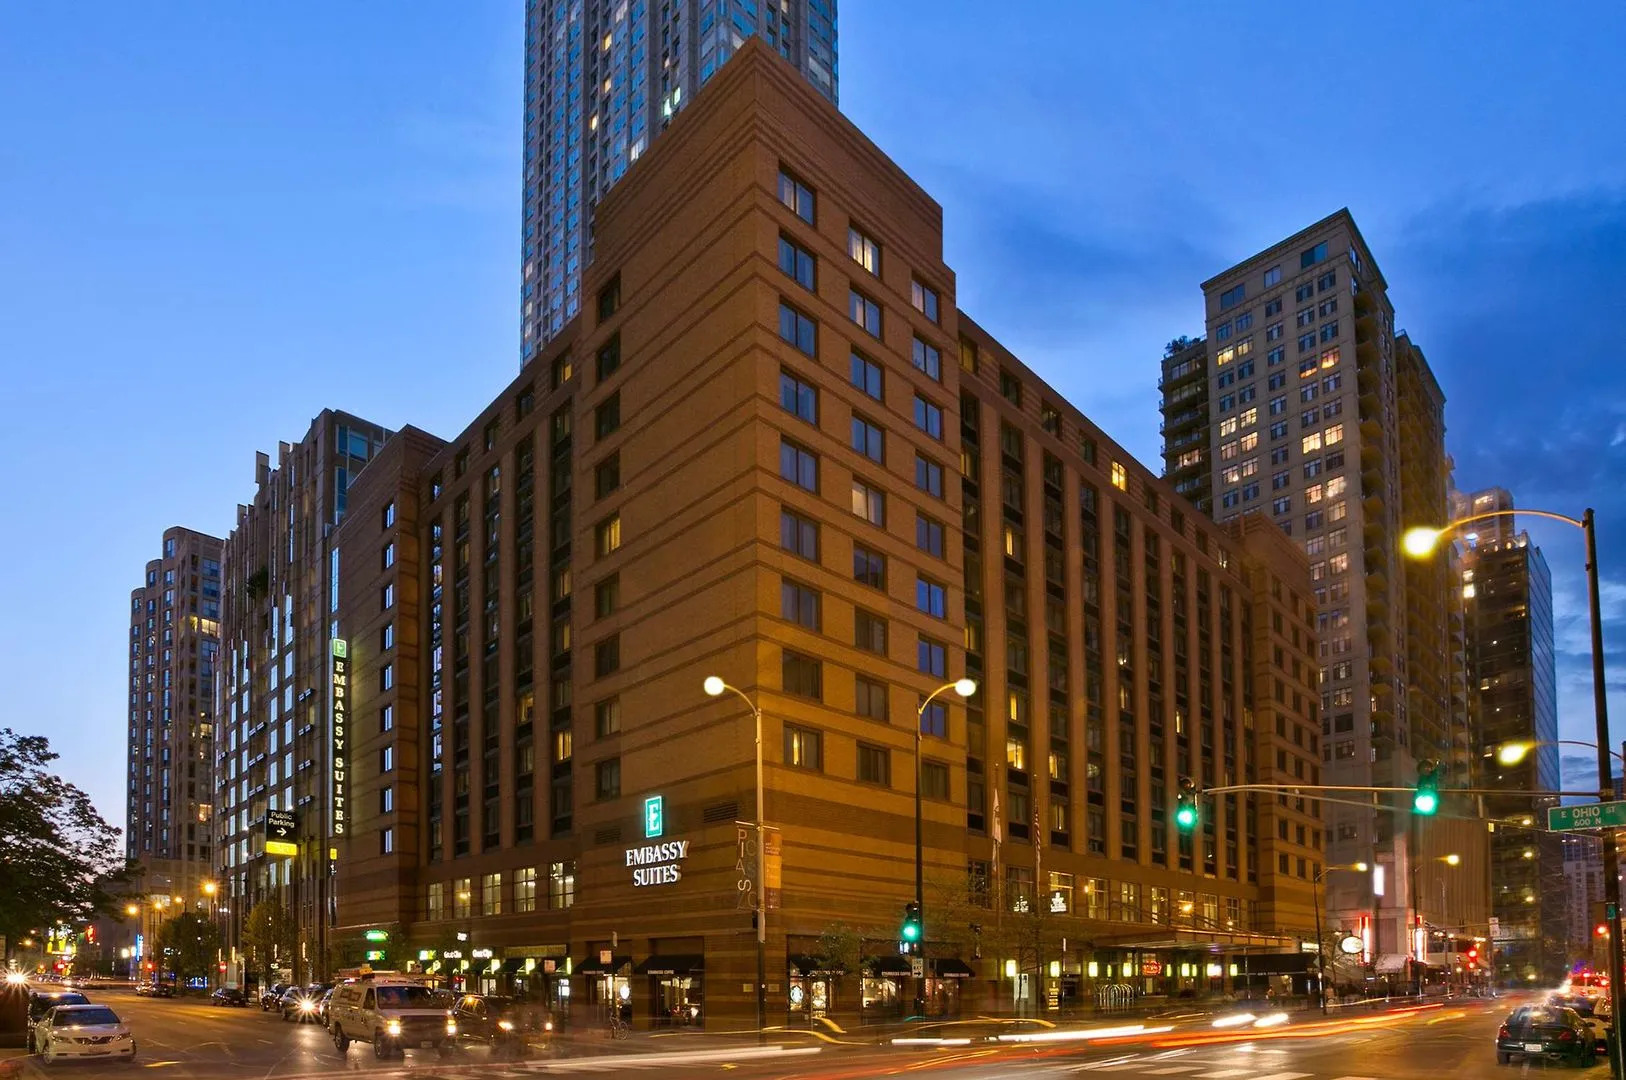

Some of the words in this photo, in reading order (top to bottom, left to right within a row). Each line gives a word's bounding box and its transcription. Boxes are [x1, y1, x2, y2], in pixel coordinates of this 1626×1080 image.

[333, 661, 346, 750] EMBASSY
[334, 757, 345, 834] SUITES
[270, 811, 293, 821] Public
[1572, 806, 1600, 818] OHIO
[1606, 806, 1616, 814] ST
[268, 818, 295, 829] Parking
[1574, 819, 1591, 827] 600
[1595, 817, 1602, 825] N
[626, 840, 689, 866] EMBASSY
[633, 864, 681, 887] SUITES
